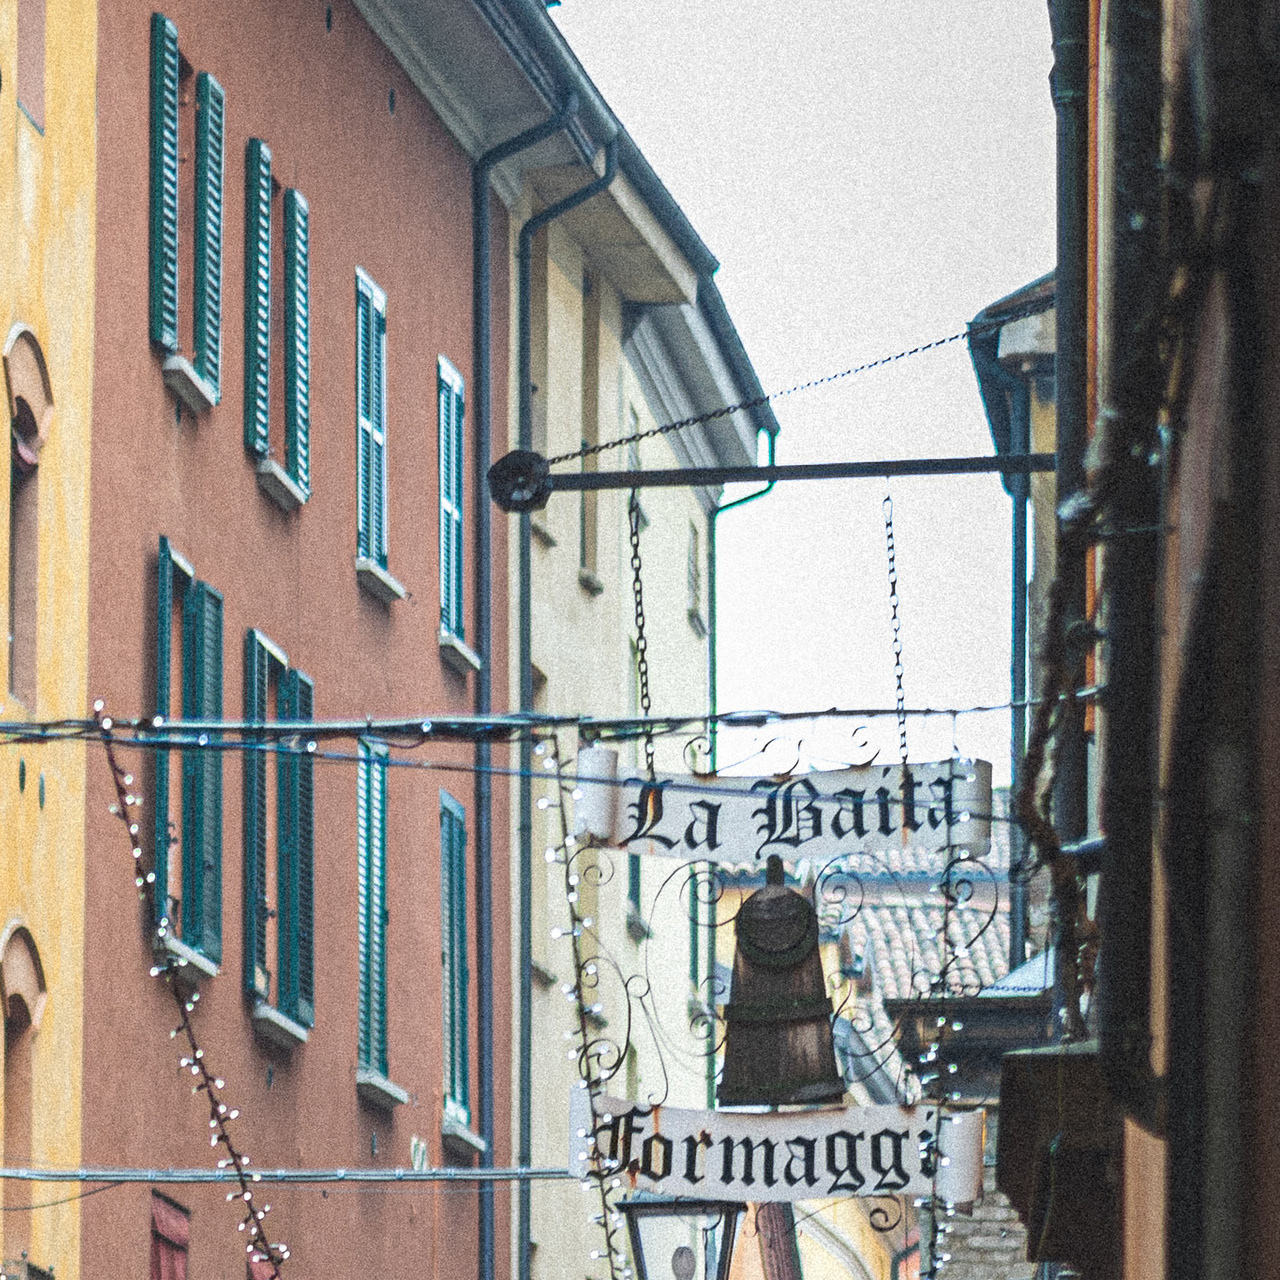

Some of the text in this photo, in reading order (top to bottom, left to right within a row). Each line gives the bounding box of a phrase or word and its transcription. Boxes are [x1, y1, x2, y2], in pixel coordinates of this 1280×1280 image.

[621, 766, 966, 860] La Baita
[586, 1105, 937, 1195] Formaggi
